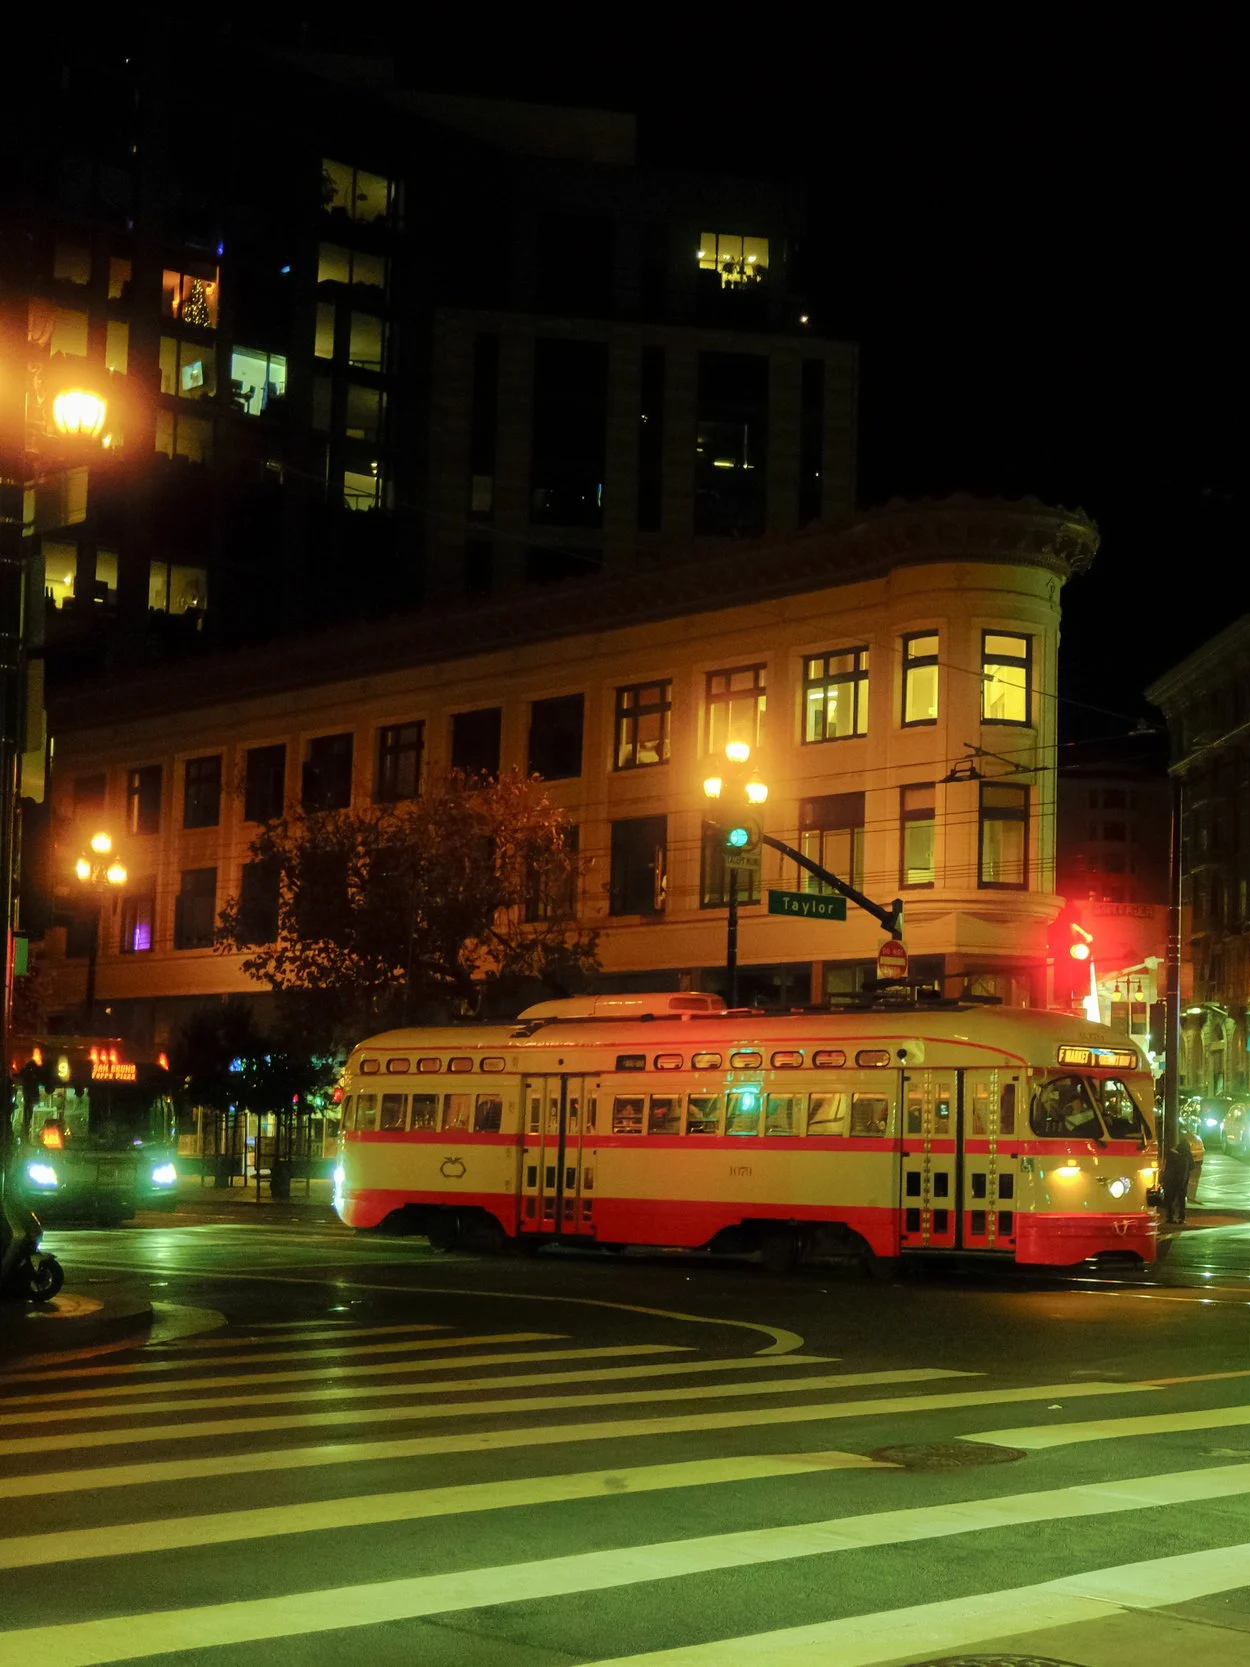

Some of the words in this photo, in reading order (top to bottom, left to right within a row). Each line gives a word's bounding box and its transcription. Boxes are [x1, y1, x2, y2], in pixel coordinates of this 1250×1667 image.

[782, 897, 834, 915] Taylor
[58, 1063, 68, 1077] 9
[110, 1064, 136, 1074] BRUNO
